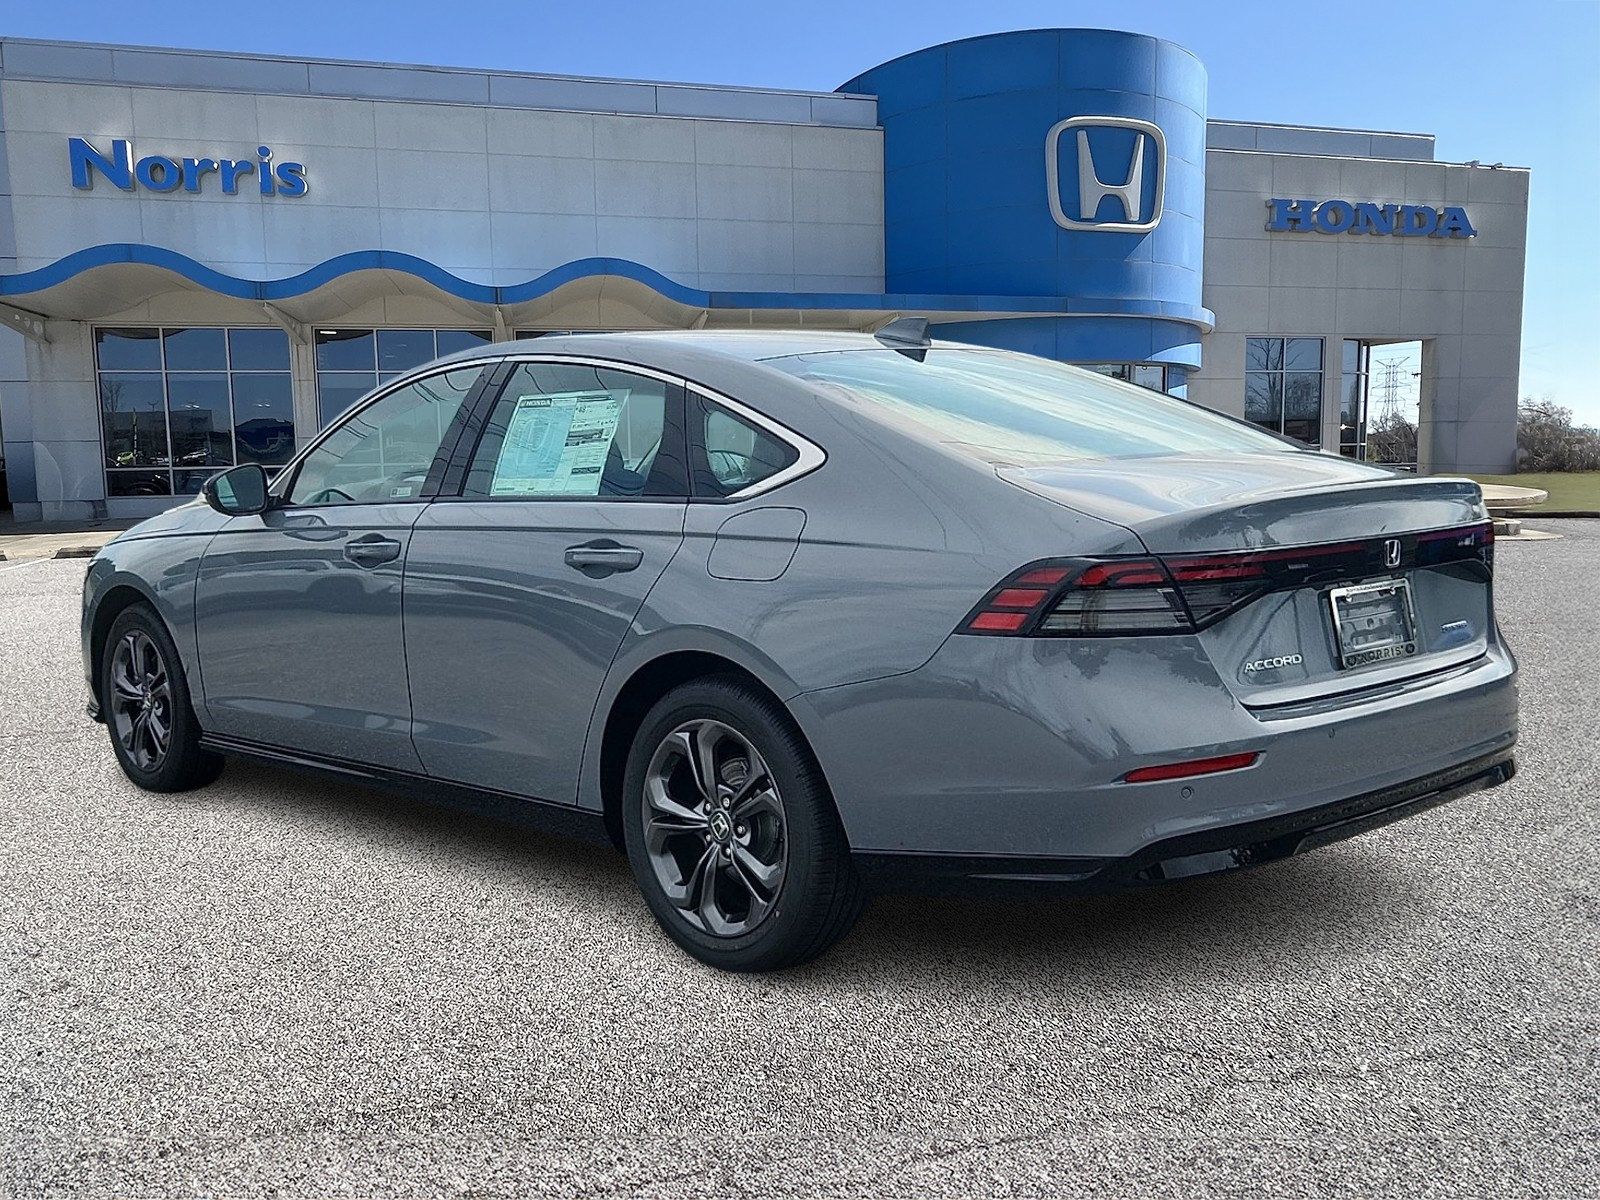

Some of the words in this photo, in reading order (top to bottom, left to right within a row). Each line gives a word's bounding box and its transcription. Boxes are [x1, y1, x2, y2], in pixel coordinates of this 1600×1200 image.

[68, 137, 308, 197] Norris
[1265, 198, 1477, 239] HONDA
[1244, 654, 1303, 674] ACCORD
[1360, 646, 1402, 663] NORRIS
